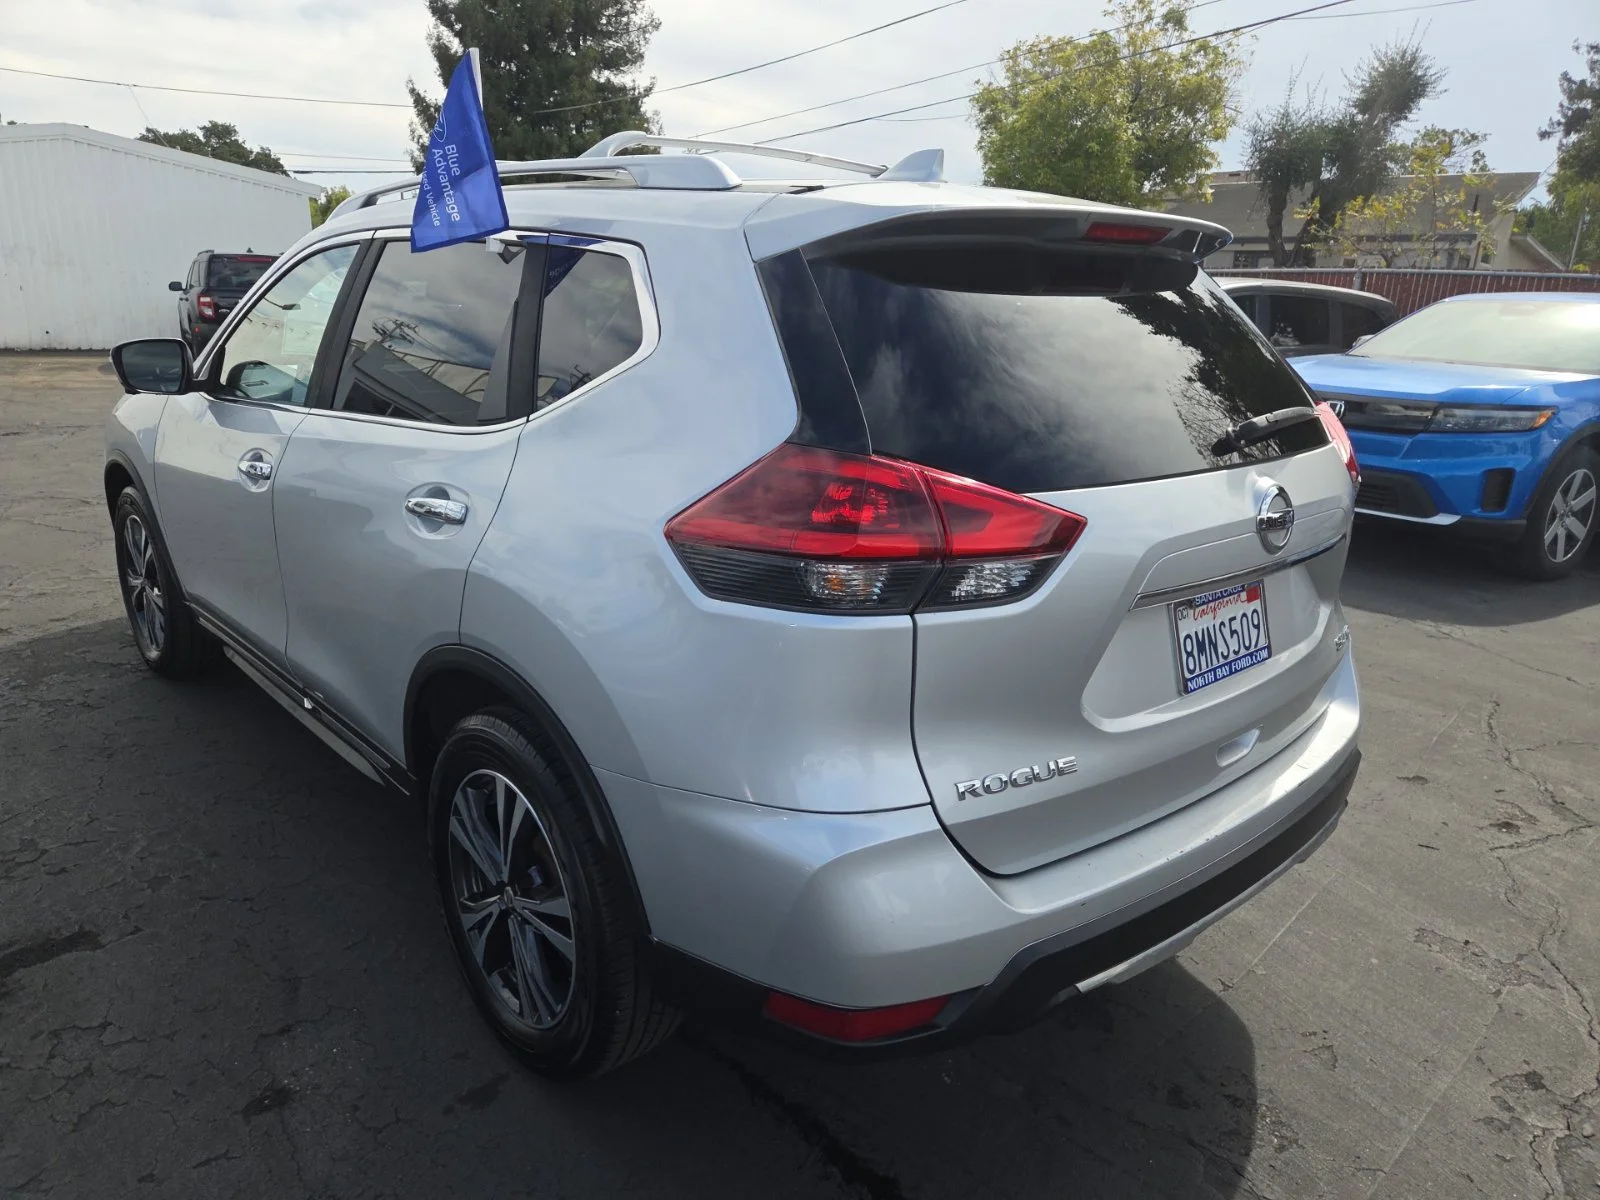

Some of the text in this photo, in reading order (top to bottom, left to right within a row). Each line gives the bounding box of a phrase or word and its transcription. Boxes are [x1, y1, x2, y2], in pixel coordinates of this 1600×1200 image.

[444, 144, 461, 177] Blue
[432, 148, 461, 222] Advantage
[426, 191, 441, 227] Vehicle
[1183, 608, 1261, 675] 8MNS509
[1187, 647, 1269, 692] NORTH BAY FORD.COM
[954, 755, 1080, 802] ROGUE
